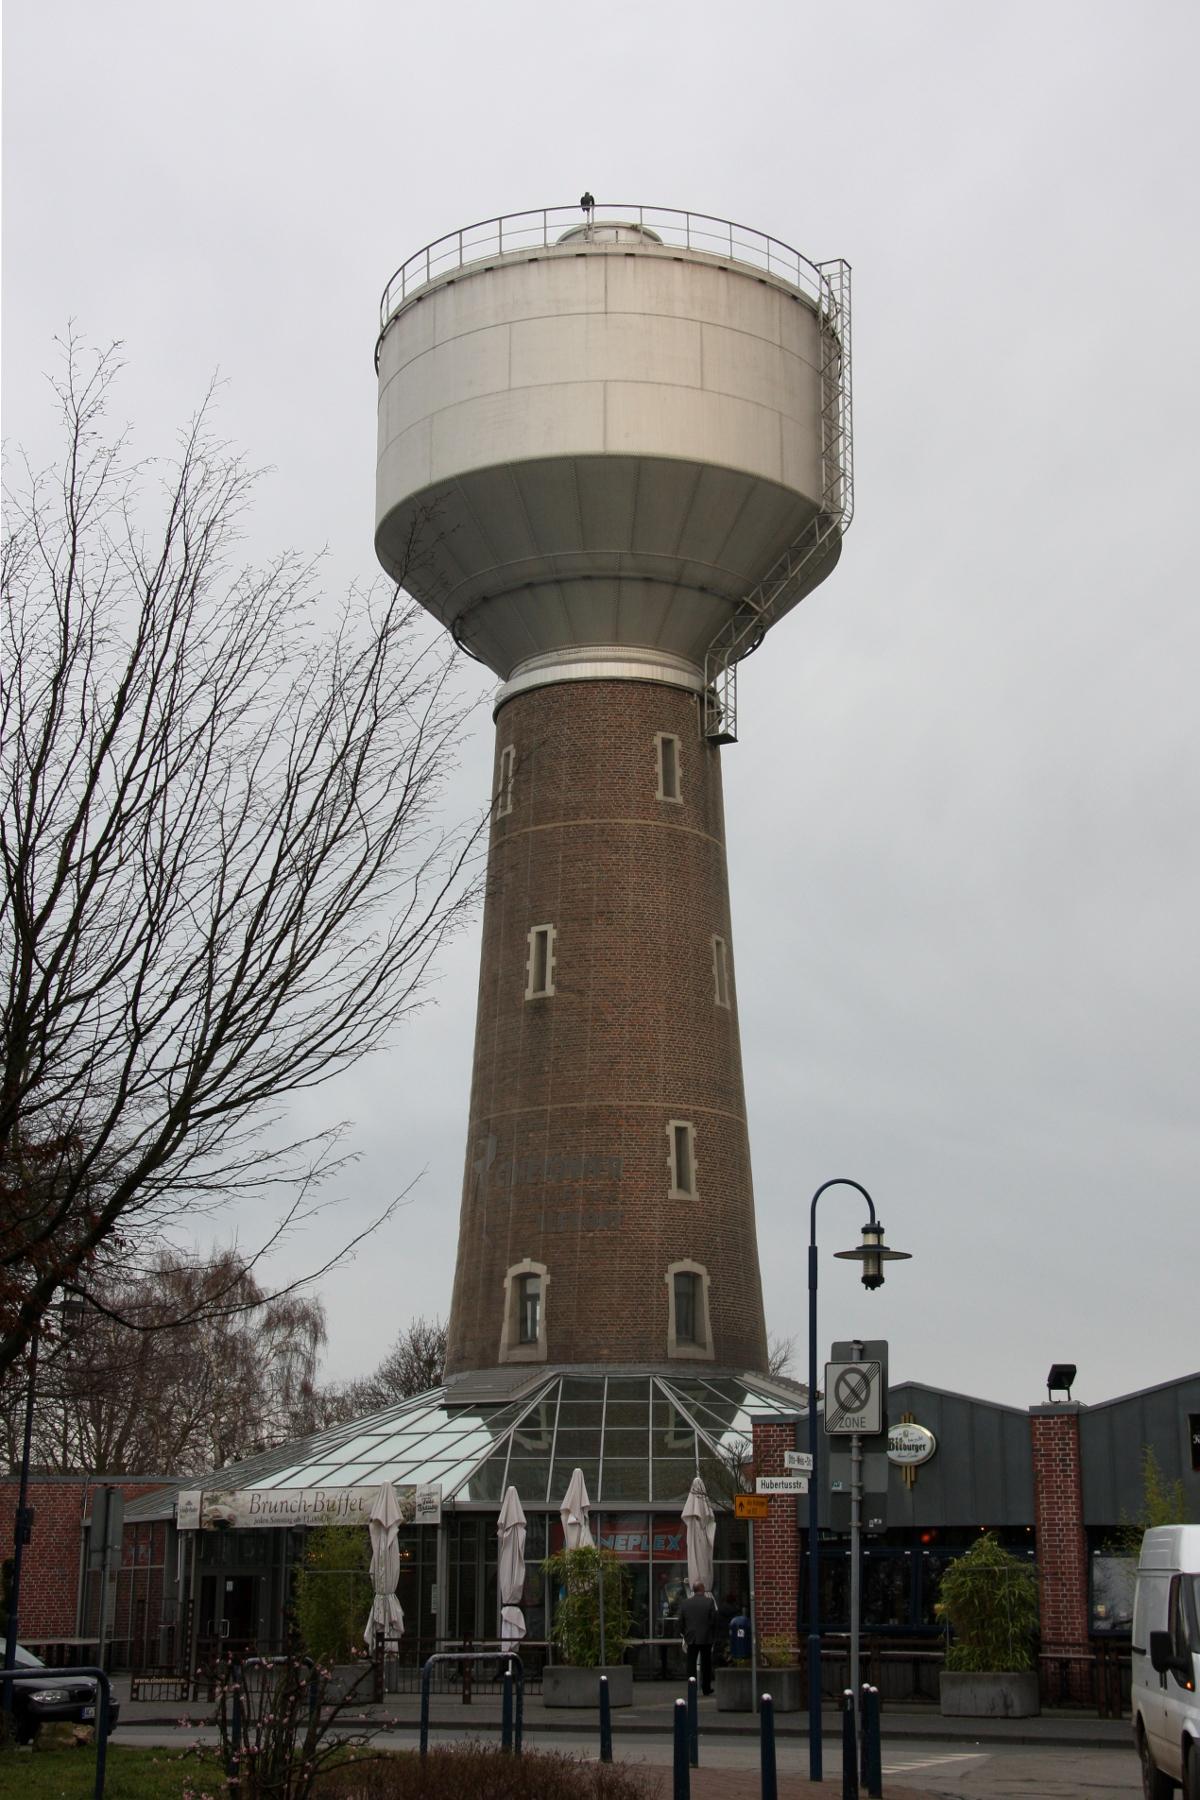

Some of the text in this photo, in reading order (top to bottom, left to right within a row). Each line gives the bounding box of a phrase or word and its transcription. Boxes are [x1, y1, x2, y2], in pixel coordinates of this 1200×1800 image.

[838, 1416, 867, 1429] ZONE
[887, 1437, 926, 1453] Bitburger
[760, 1479, 805, 1489] Hubertusstr.
[248, 1489, 364, 1517] Brunch-Buffet
[590, 1534, 682, 1552] NEPLEX
